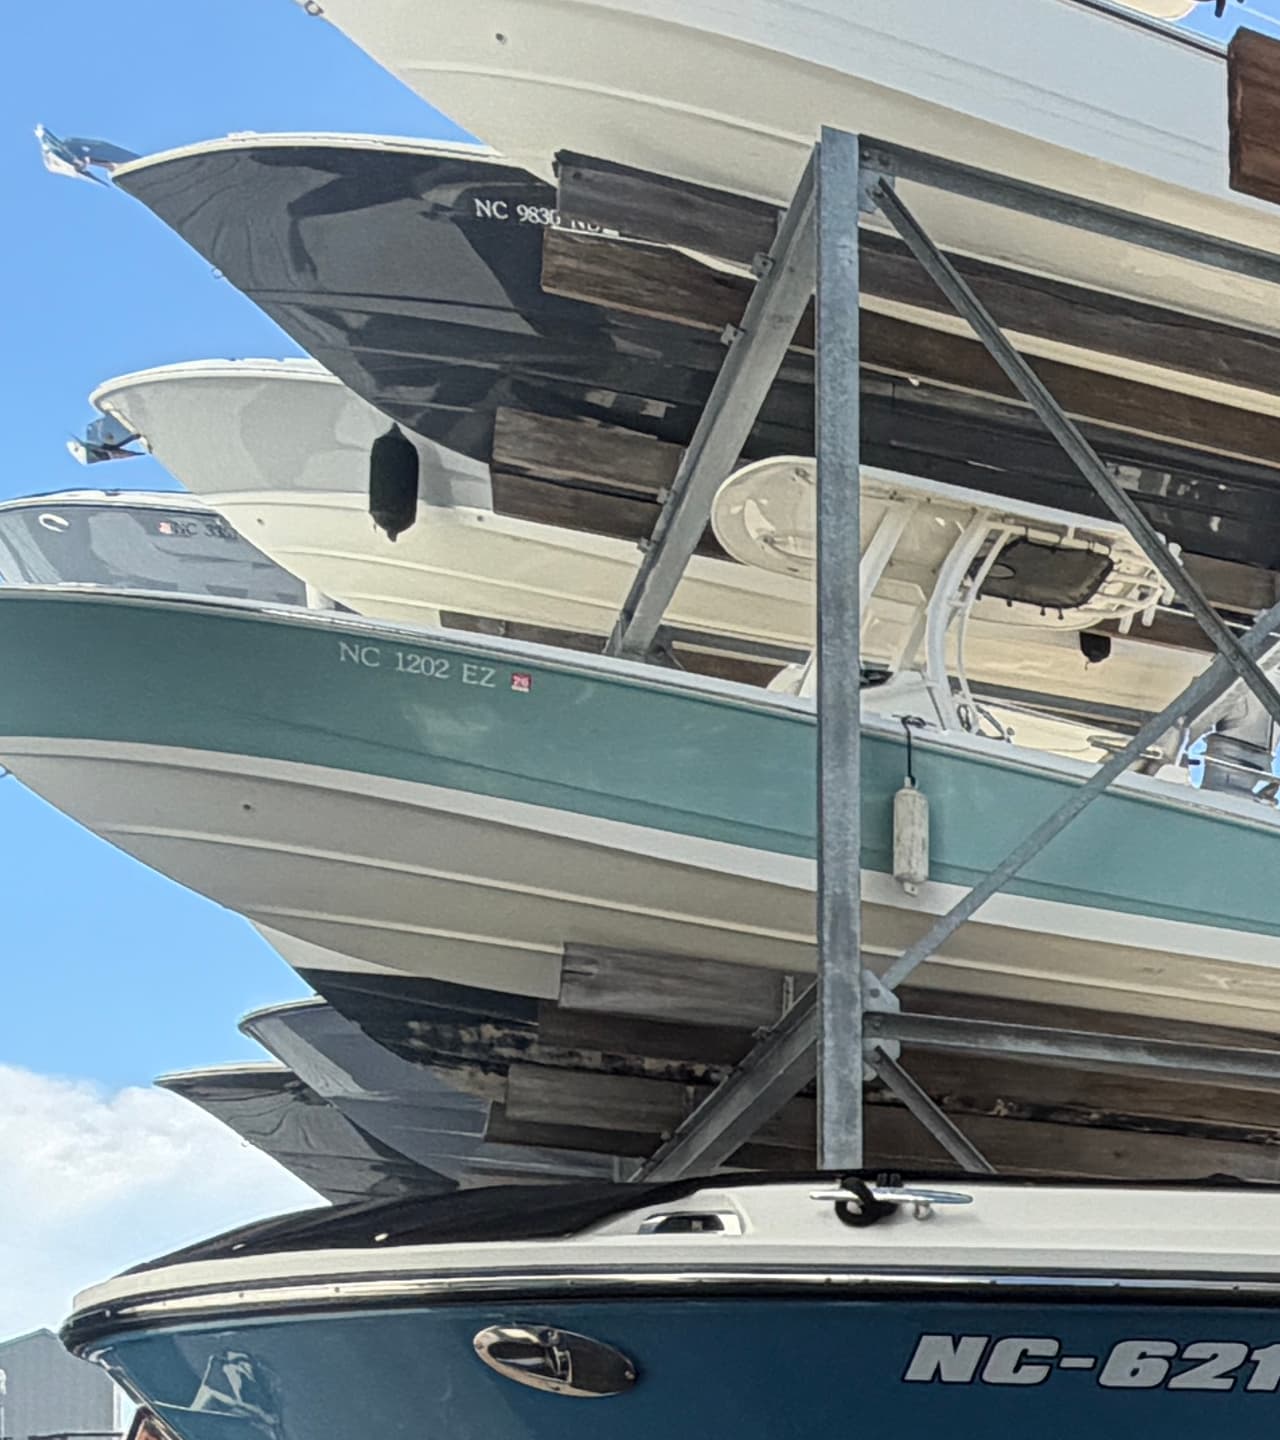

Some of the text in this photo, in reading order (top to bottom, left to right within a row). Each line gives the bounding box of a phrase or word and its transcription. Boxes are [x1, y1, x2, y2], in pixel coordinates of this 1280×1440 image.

[474, 199, 508, 219] NC
[338, 642, 496, 688] NC 1202 EZ
